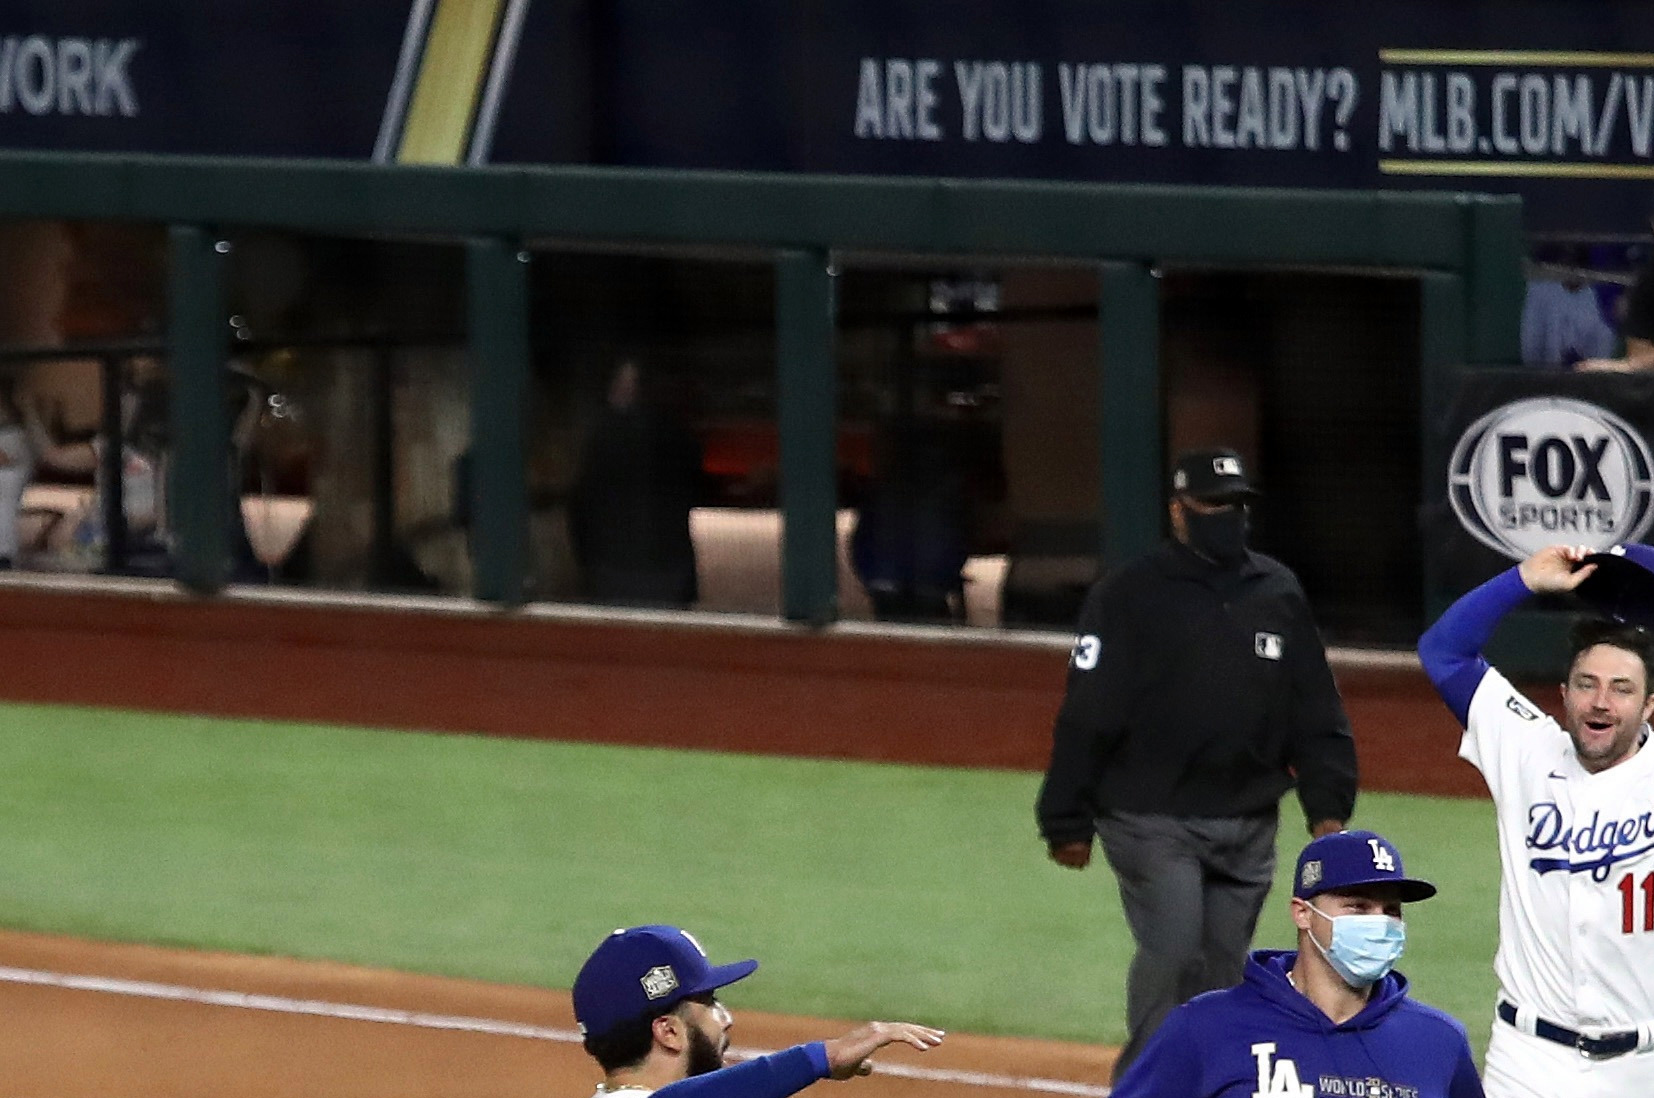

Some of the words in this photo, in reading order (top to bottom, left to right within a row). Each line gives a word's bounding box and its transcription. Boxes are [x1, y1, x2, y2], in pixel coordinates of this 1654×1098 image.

[855, 57, 943, 141] ARE
[954, 60, 1043, 143] YOU
[1058, 62, 1167, 147] VOTE
[1182, 64, 1357, 152] READY?
[1497, 433, 1612, 500] FOX
[1499, 503, 1615, 533] SPORTS
[1069, 634, 1101, 670] 3
[1367, 838, 1396, 872] LA
